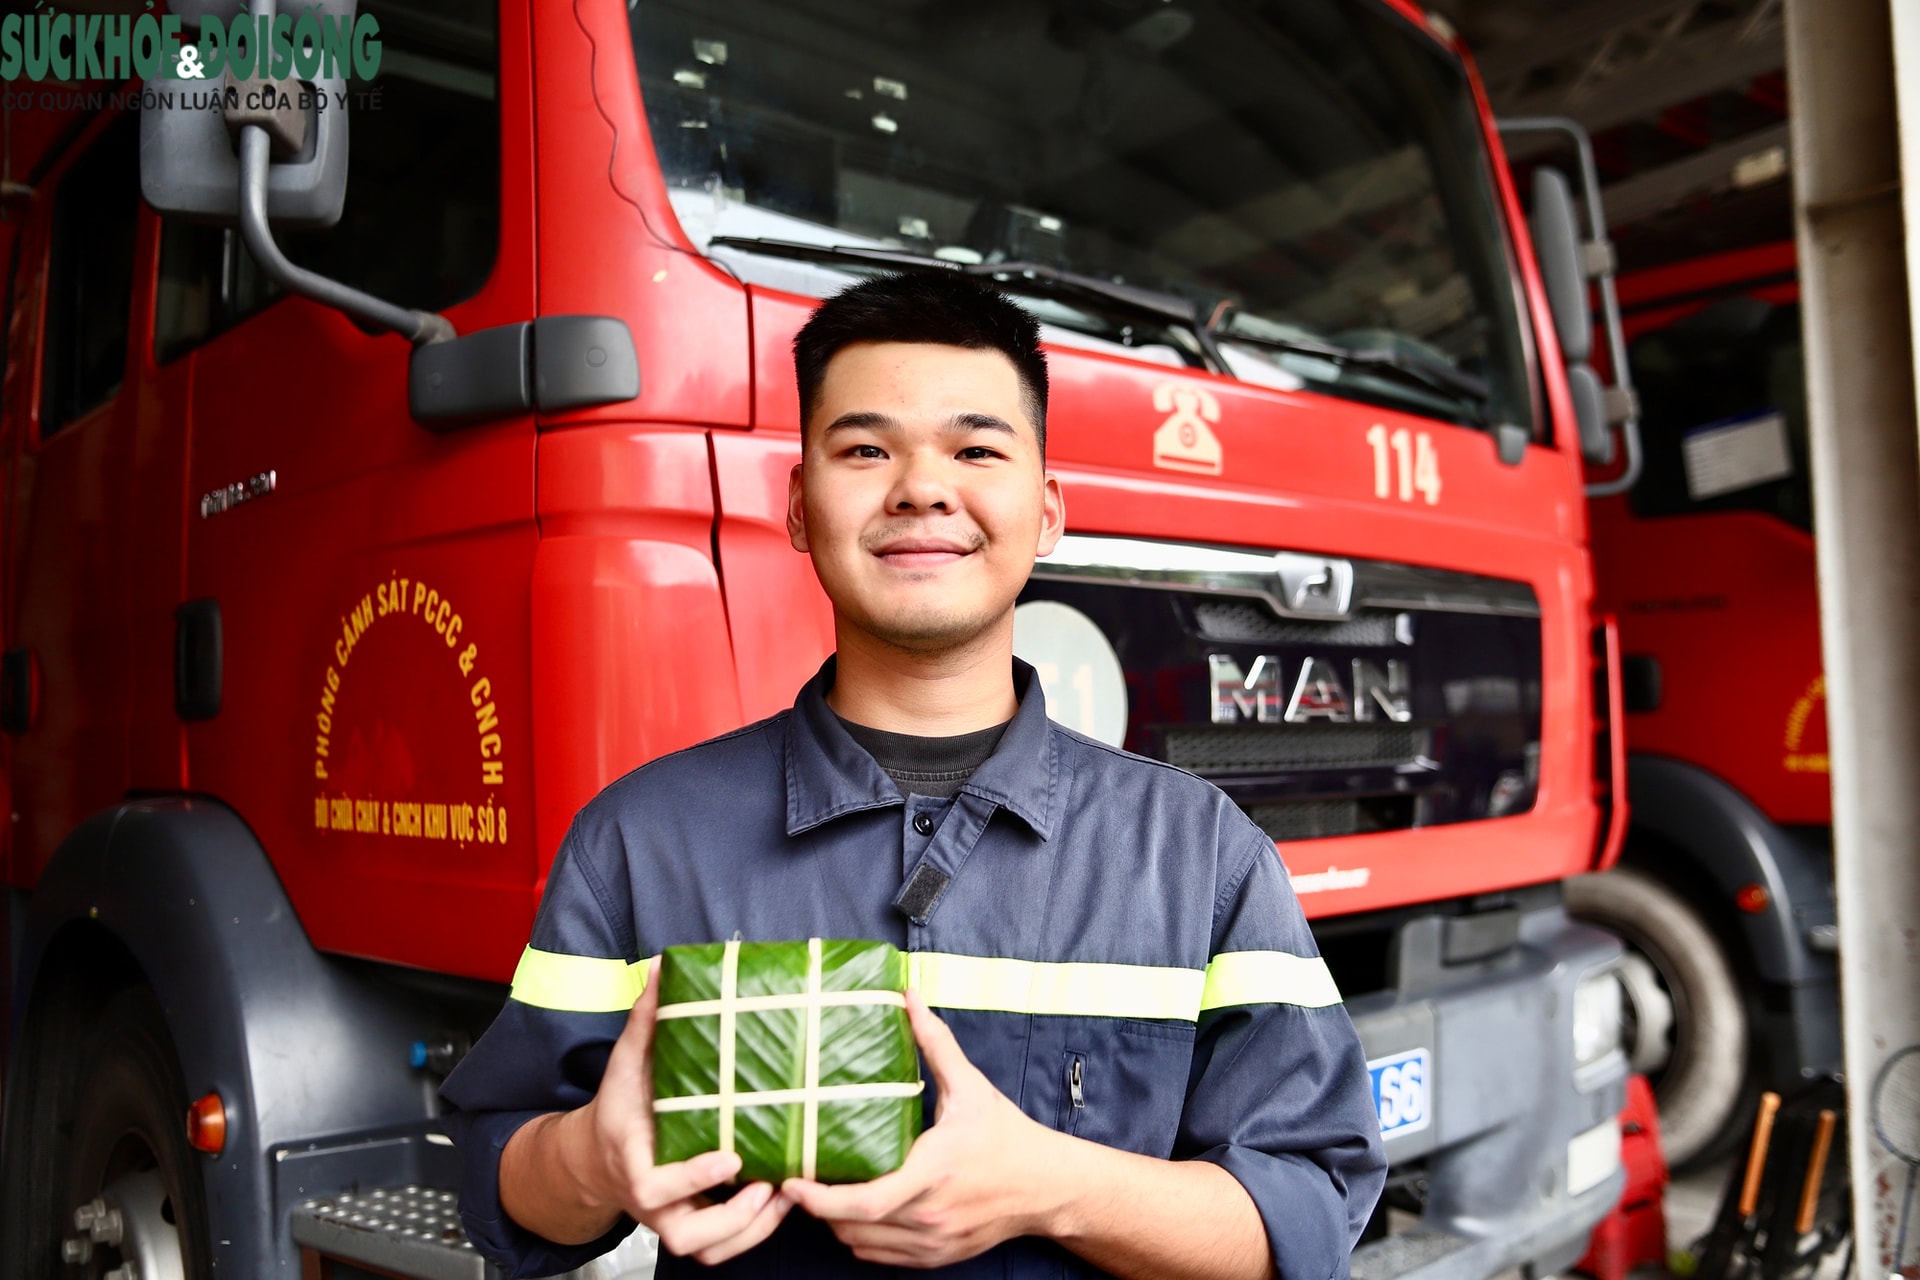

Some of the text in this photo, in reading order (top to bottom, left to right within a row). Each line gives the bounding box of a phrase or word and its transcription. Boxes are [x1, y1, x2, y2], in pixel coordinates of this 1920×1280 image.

[1366, 423, 1442, 505] 114
[413, 581, 463, 648] PCCC
[459, 643, 478, 677] &
[470, 677, 504, 784] CNCH
[1209, 654, 1412, 723] MAN
[424, 803, 448, 840] KHU
[449, 801, 475, 850] VỰC
[477, 792, 496, 844] SỐ
[498, 806, 507, 845] 8
